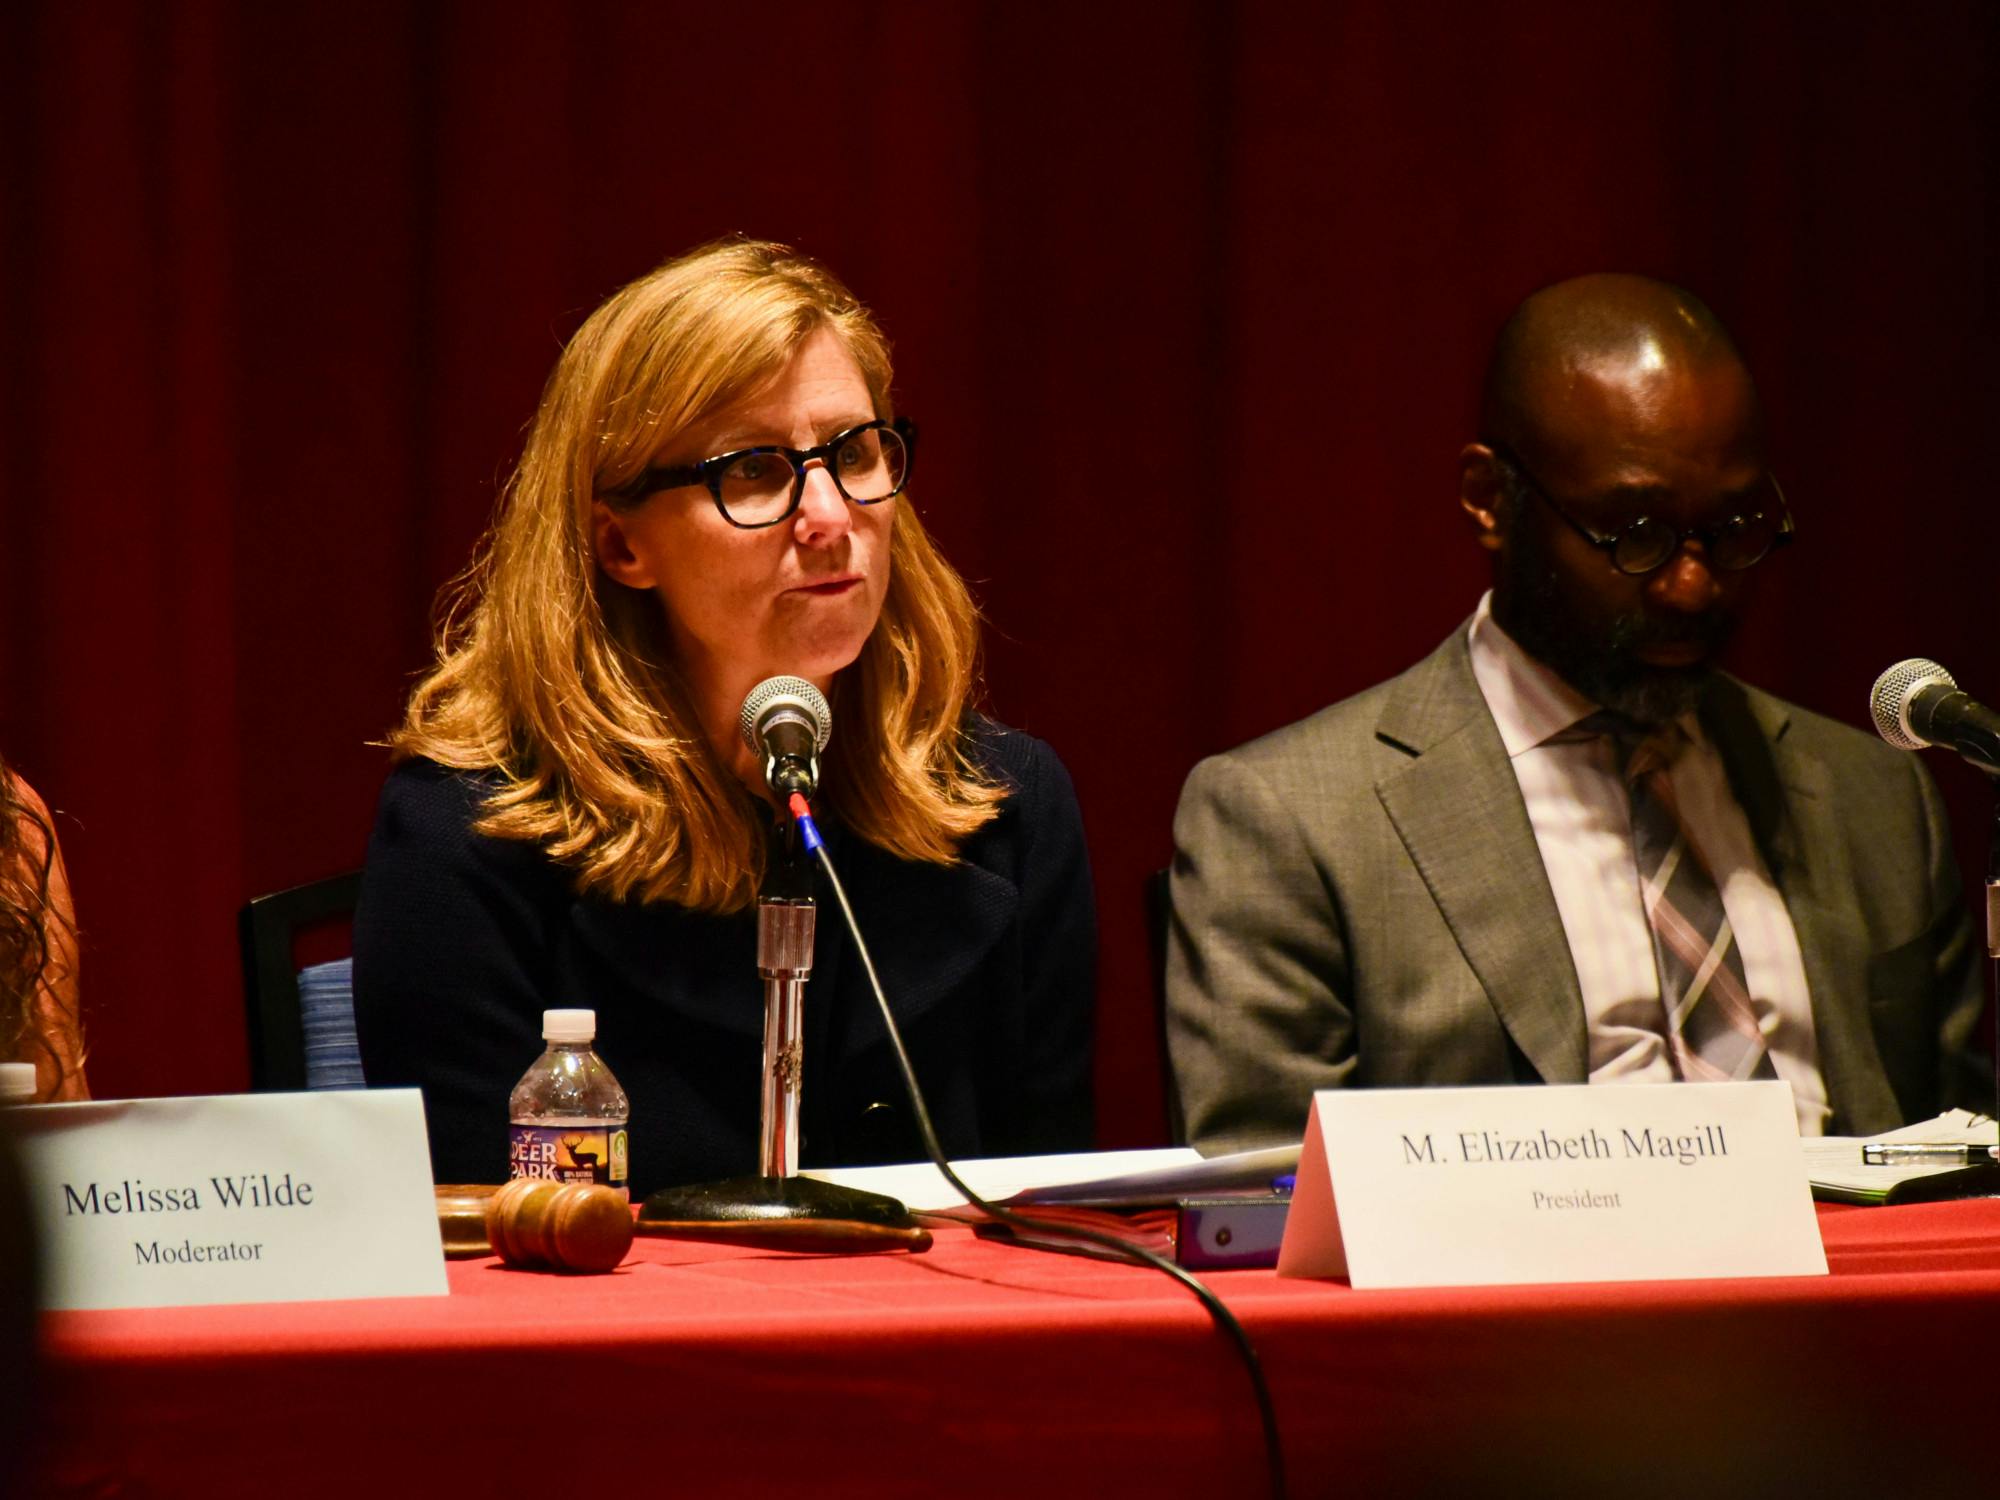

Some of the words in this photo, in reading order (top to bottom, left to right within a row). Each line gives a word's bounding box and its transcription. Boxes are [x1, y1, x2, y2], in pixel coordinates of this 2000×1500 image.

[511, 1141, 557, 1162] DEER
[1402, 1133, 1448, 1164] M.
[1458, 1129, 1611, 1163] Elizabeth
[1622, 1126, 1729, 1166] Magill
[511, 1162, 558, 1182] PARK
[63, 1180, 200, 1216] Melissa
[211, 1174, 314, 1208] Wilde
[1532, 1189, 1622, 1210] President
[134, 1240, 263, 1265] Moderator
